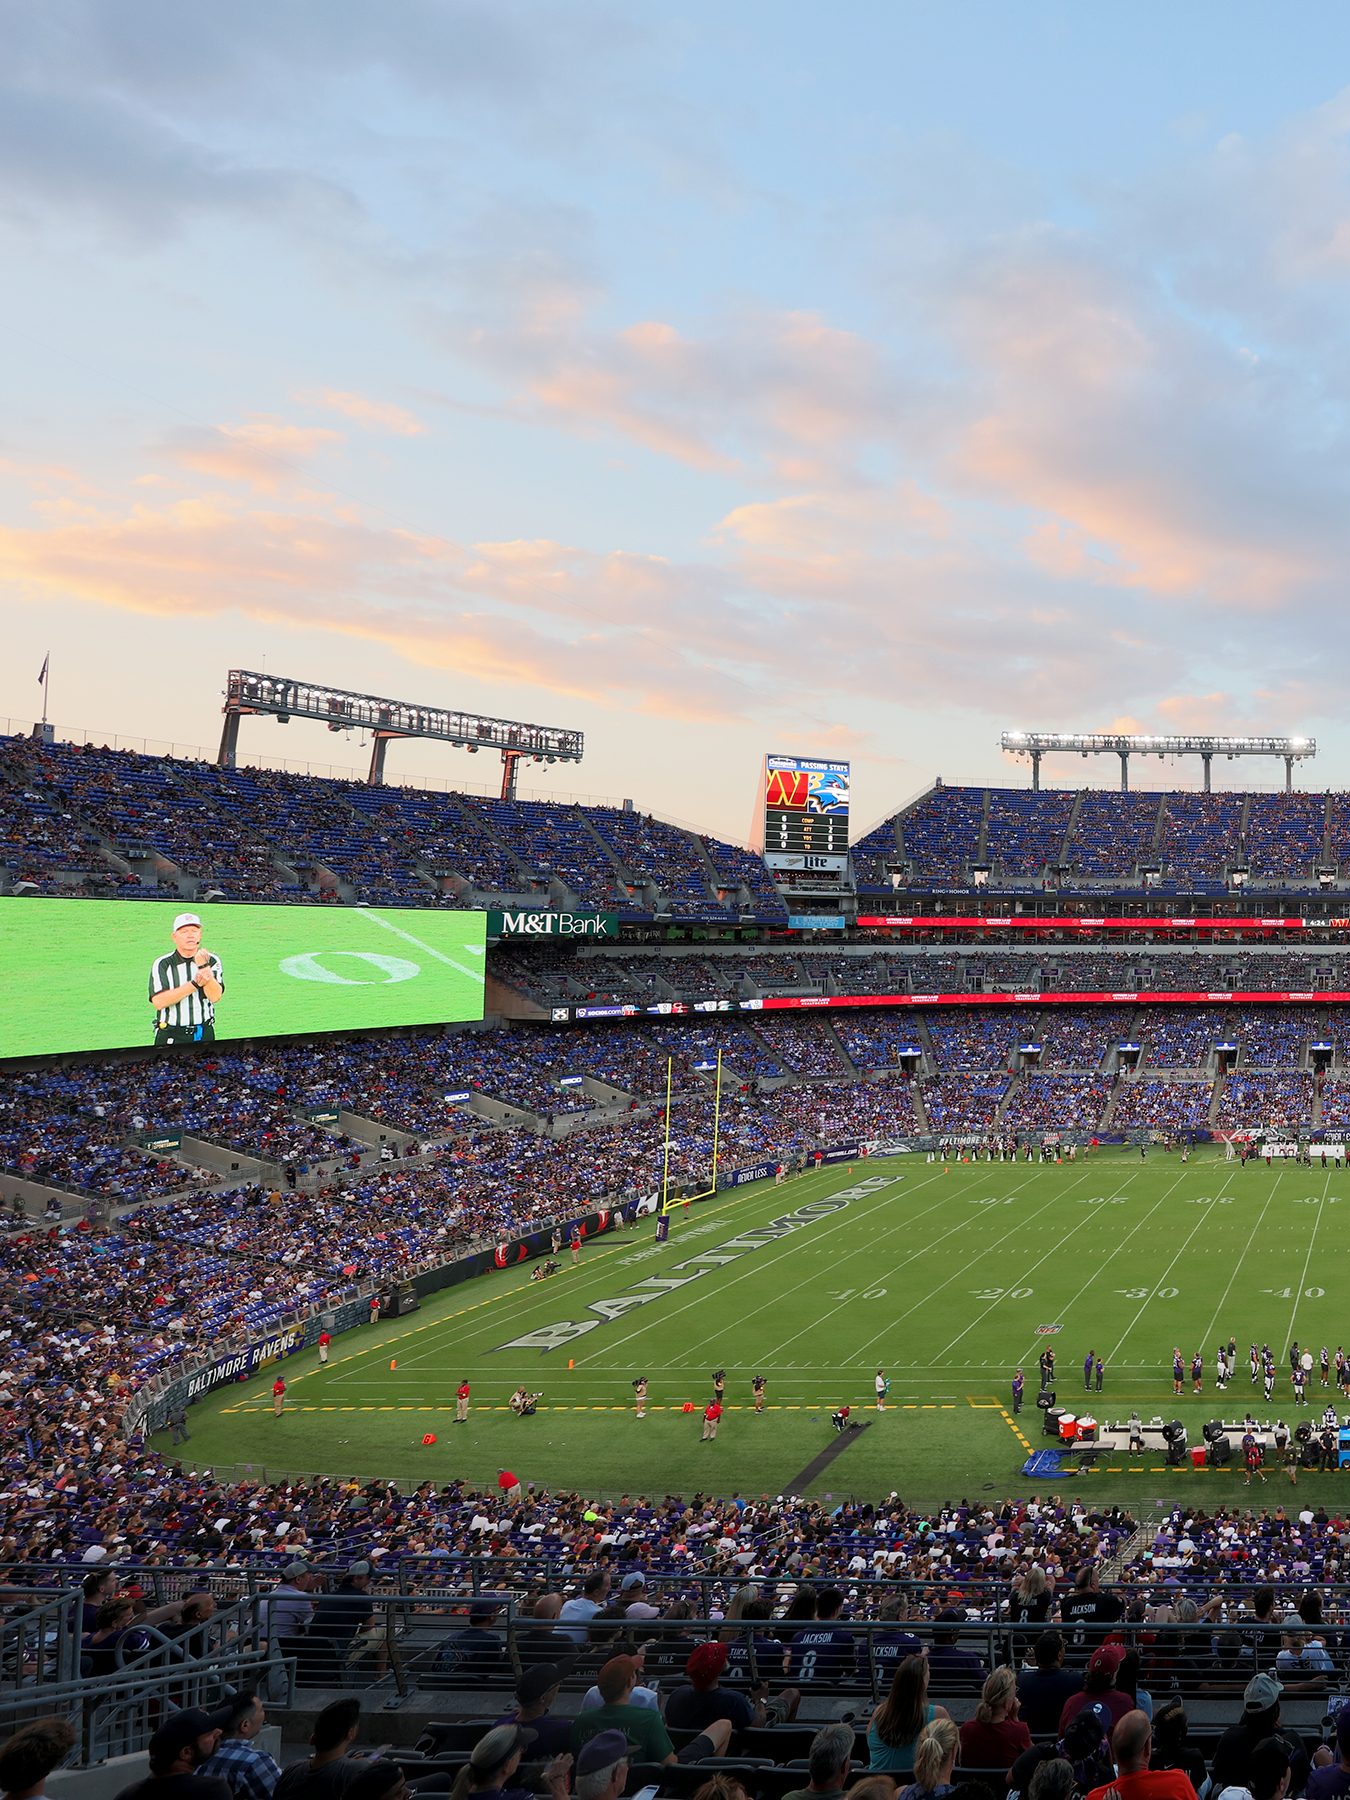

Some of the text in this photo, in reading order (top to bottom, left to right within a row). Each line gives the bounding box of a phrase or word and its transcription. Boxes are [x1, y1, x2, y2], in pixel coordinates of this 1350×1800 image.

[801, 762, 828, 770] PASSING
[804, 856, 827, 869] Lite
[502, 912, 607, 934] M&T Bank
[939, 1136, 981, 1146] BALTIMORE
[738, 1170, 754, 1183] NEVER
[477, 1175, 908, 1357] BALTIMORE
[834, 1287, 888, 1300] 10
[975, 1287, 1034, 1299] 20
[1128, 1287, 1179, 1299] 30
[1272, 1287, 1326, 1299] 40
[1040, 1326, 1058, 1334] NFL
[187, 1332, 295, 1397] BALTIMORE RAVENS
[424, 1435, 431, 1444] G
[1070, 1603, 1096, 1615] JACKSON
[800, 1632, 833, 1644] JACKSON
[798, 1650, 817, 1681] 8
